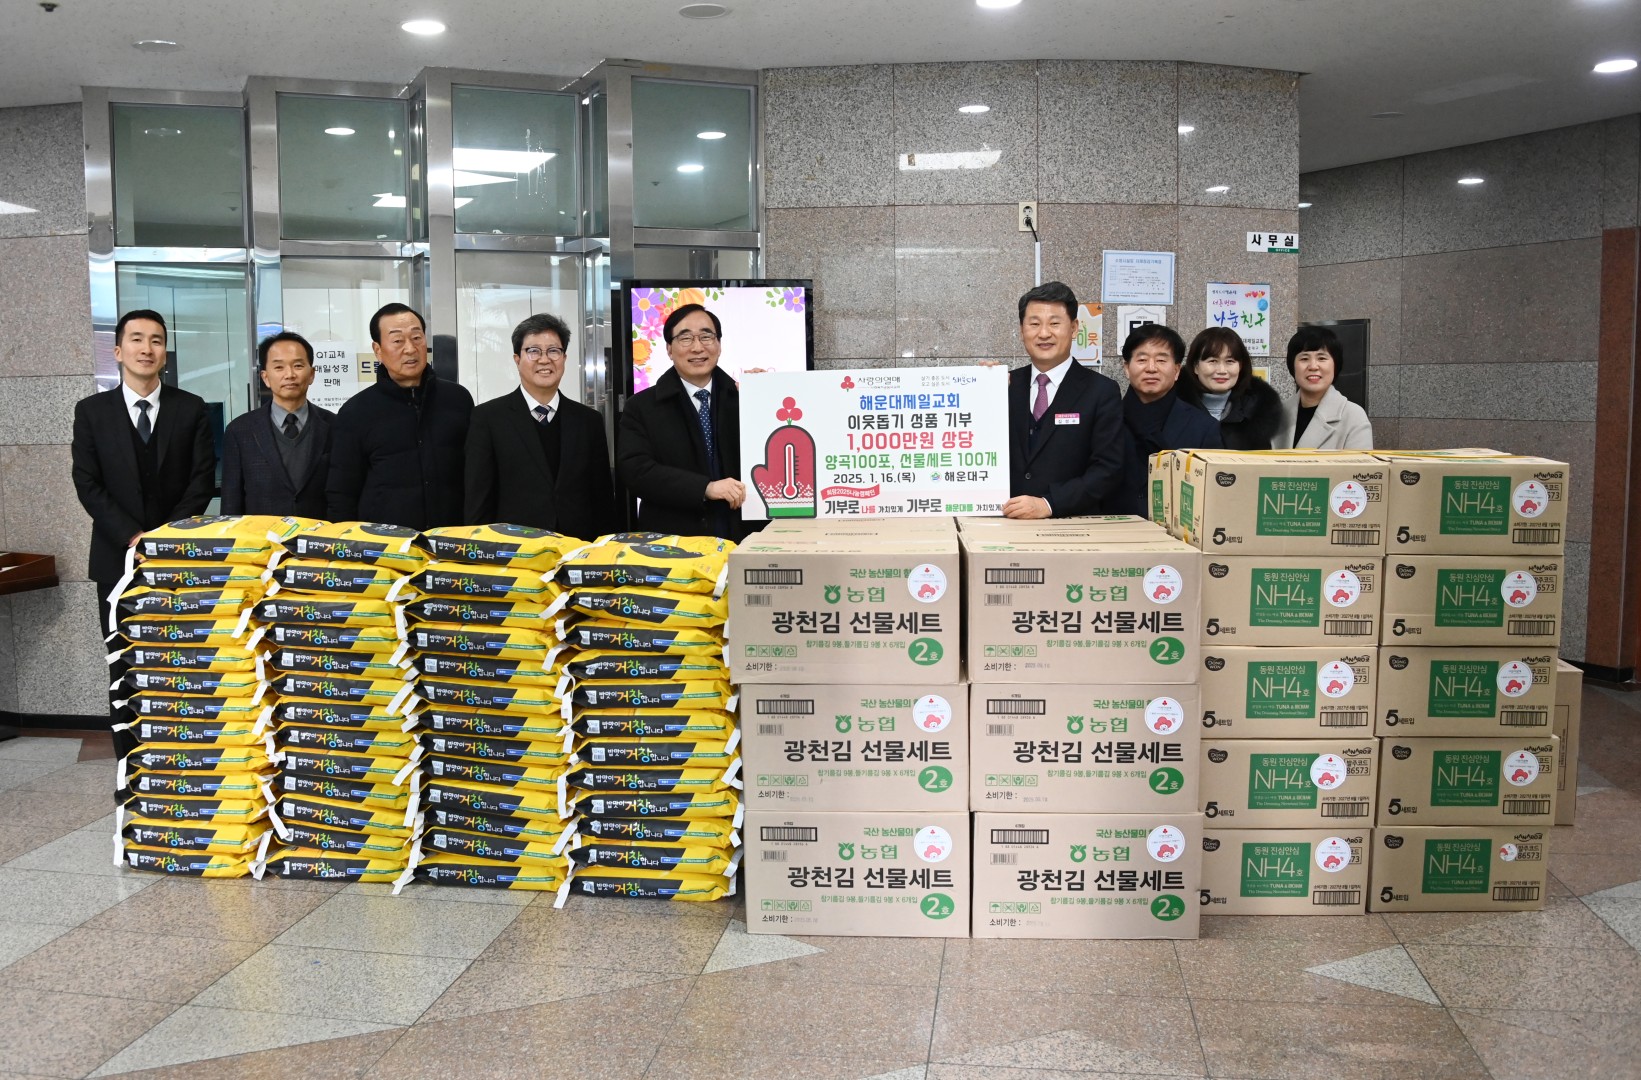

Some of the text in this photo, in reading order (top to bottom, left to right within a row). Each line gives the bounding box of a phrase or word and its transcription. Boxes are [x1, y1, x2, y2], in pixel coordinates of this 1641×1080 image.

[1251, 234, 1293, 247] 사무실
[316, 351, 345, 359] QT교재
[314, 364, 349, 373] 매일성경
[324, 378, 341, 387] 판매
[860, 393, 960, 410] 해운대제일교회
[848, 412, 972, 430] 이웃돕기 성품 기부
[847, 430, 974, 453] 1,000만원 상당
[825, 451, 997, 471] 양곡100포, 선물세트 100개
[833, 472, 916, 484] 2025. 1. 16.(목)
[945, 471, 989, 482] 해운대구
[1271, 482, 1318, 491] 동원 진심안심
[1454, 481, 1500, 490] 동원 진심안심
[824, 500, 860, 514] 기부로
[862, 505, 876, 514] 나를
[878, 505, 903, 514] 가치있게
[906, 499, 942, 513] 기부로
[945, 503, 974, 513] 해운대를
[1263, 493, 1322, 515] NH4호
[1446, 492, 1503, 514] NH4호
[1212, 527, 1243, 545] 5세트입
[1397, 526, 1426, 544] 5세트입
[175, 542, 212, 557] 거창합니다
[309, 541, 325, 549] 밥맛이
[324, 542, 363, 559] 거창합니다
[437, 542, 495, 559] 밥맛이 거창합니다
[296, 571, 352, 588] 밥맛이 거창합니다
[850, 568, 866, 578] 국산
[868, 568, 901, 578] 농산물의
[1092, 567, 1145, 577] 국산 농산물의
[1264, 573, 1310, 582] 동원 진심안심
[1449, 573, 1495, 582] 동원 진심안심
[434, 577, 491, 593] 밥맛이 거창합니다
[847, 586, 886, 603] 농협
[1089, 585, 1128, 602] 농협
[1256, 584, 1314, 606] NH4호
[1442, 584, 1498, 607] NH4호
[771, 610, 943, 634] 광천김 선물세트
[1011, 610, 1184, 634] 광천김 선물세트
[1206, 618, 1236, 636] 5세트입
[142, 624, 194, 640] 밥맛이 거창합니다
[889, 641, 906, 649] 6개입
[914, 641, 939, 662] 2호
[1156, 640, 1180, 661] 2호
[295, 654, 349, 671] 밥맛이 거창합니다
[439, 661, 495, 677] 밥맛이 거창합니다
[745, 662, 773, 672] 소비기한
[984, 662, 1012, 671] 소비기한
[1259, 665, 1306, 675] 동원 진심안심
[1443, 665, 1487, 674] 동원 진심안심
[1252, 677, 1310, 698] NH4호
[1434, 676, 1491, 697] NH4호
[599, 689, 660, 705] 밥맛이 거창합니다
[860, 699, 911, 708] 국산 농산물의
[1093, 700, 1144, 709] 국산 농산물의
[602, 719, 663, 735] 밥맛이 거창합니다
[857, 716, 895, 732] 농협
[1090, 717, 1128, 733] 농협
[1202, 711, 1232, 728] 5세트입
[152, 725, 203, 740] 밥맛이 거창합니다
[607, 748, 626, 757] 밥맛이
[626, 747, 669, 763] 거창합니다
[784, 740, 952, 762] 광천김 선물세트
[1013, 741, 1184, 764] 광천김 선물세트
[1262, 757, 1308, 766] 동원 진심안심
[1445, 755, 1490, 764] 동원 진심안심
[1346, 766, 1368, 774] 86573
[1437, 766, 1493, 787] NH4호
[595, 774, 657, 789] 밥맛이 거창합니다
[925, 770, 949, 789] 2호
[1155, 771, 1179, 791] 2호
[1254, 769, 1312, 789] NH4호
[758, 791, 785, 799] 소비기한
[985, 791, 1013, 800] 소비기한
[1205, 801, 1235, 818] 5세트입
[1388, 798, 1417, 816] 5세트입
[861, 844, 898, 860] 농협
[1092, 846, 1130, 862] 농협
[1254, 846, 1300, 855] 동원 진심안심
[1437, 843, 1481, 852] 동원 진심안심
[1247, 857, 1304, 878] NH4호
[1428, 854, 1484, 874] NH4호
[787, 866, 954, 889] 광천김 선물세트
[1017, 870, 1185, 892] 광천김 선물세트
[926, 896, 950, 916] 2호
[1156, 898, 1180, 917] 2호
